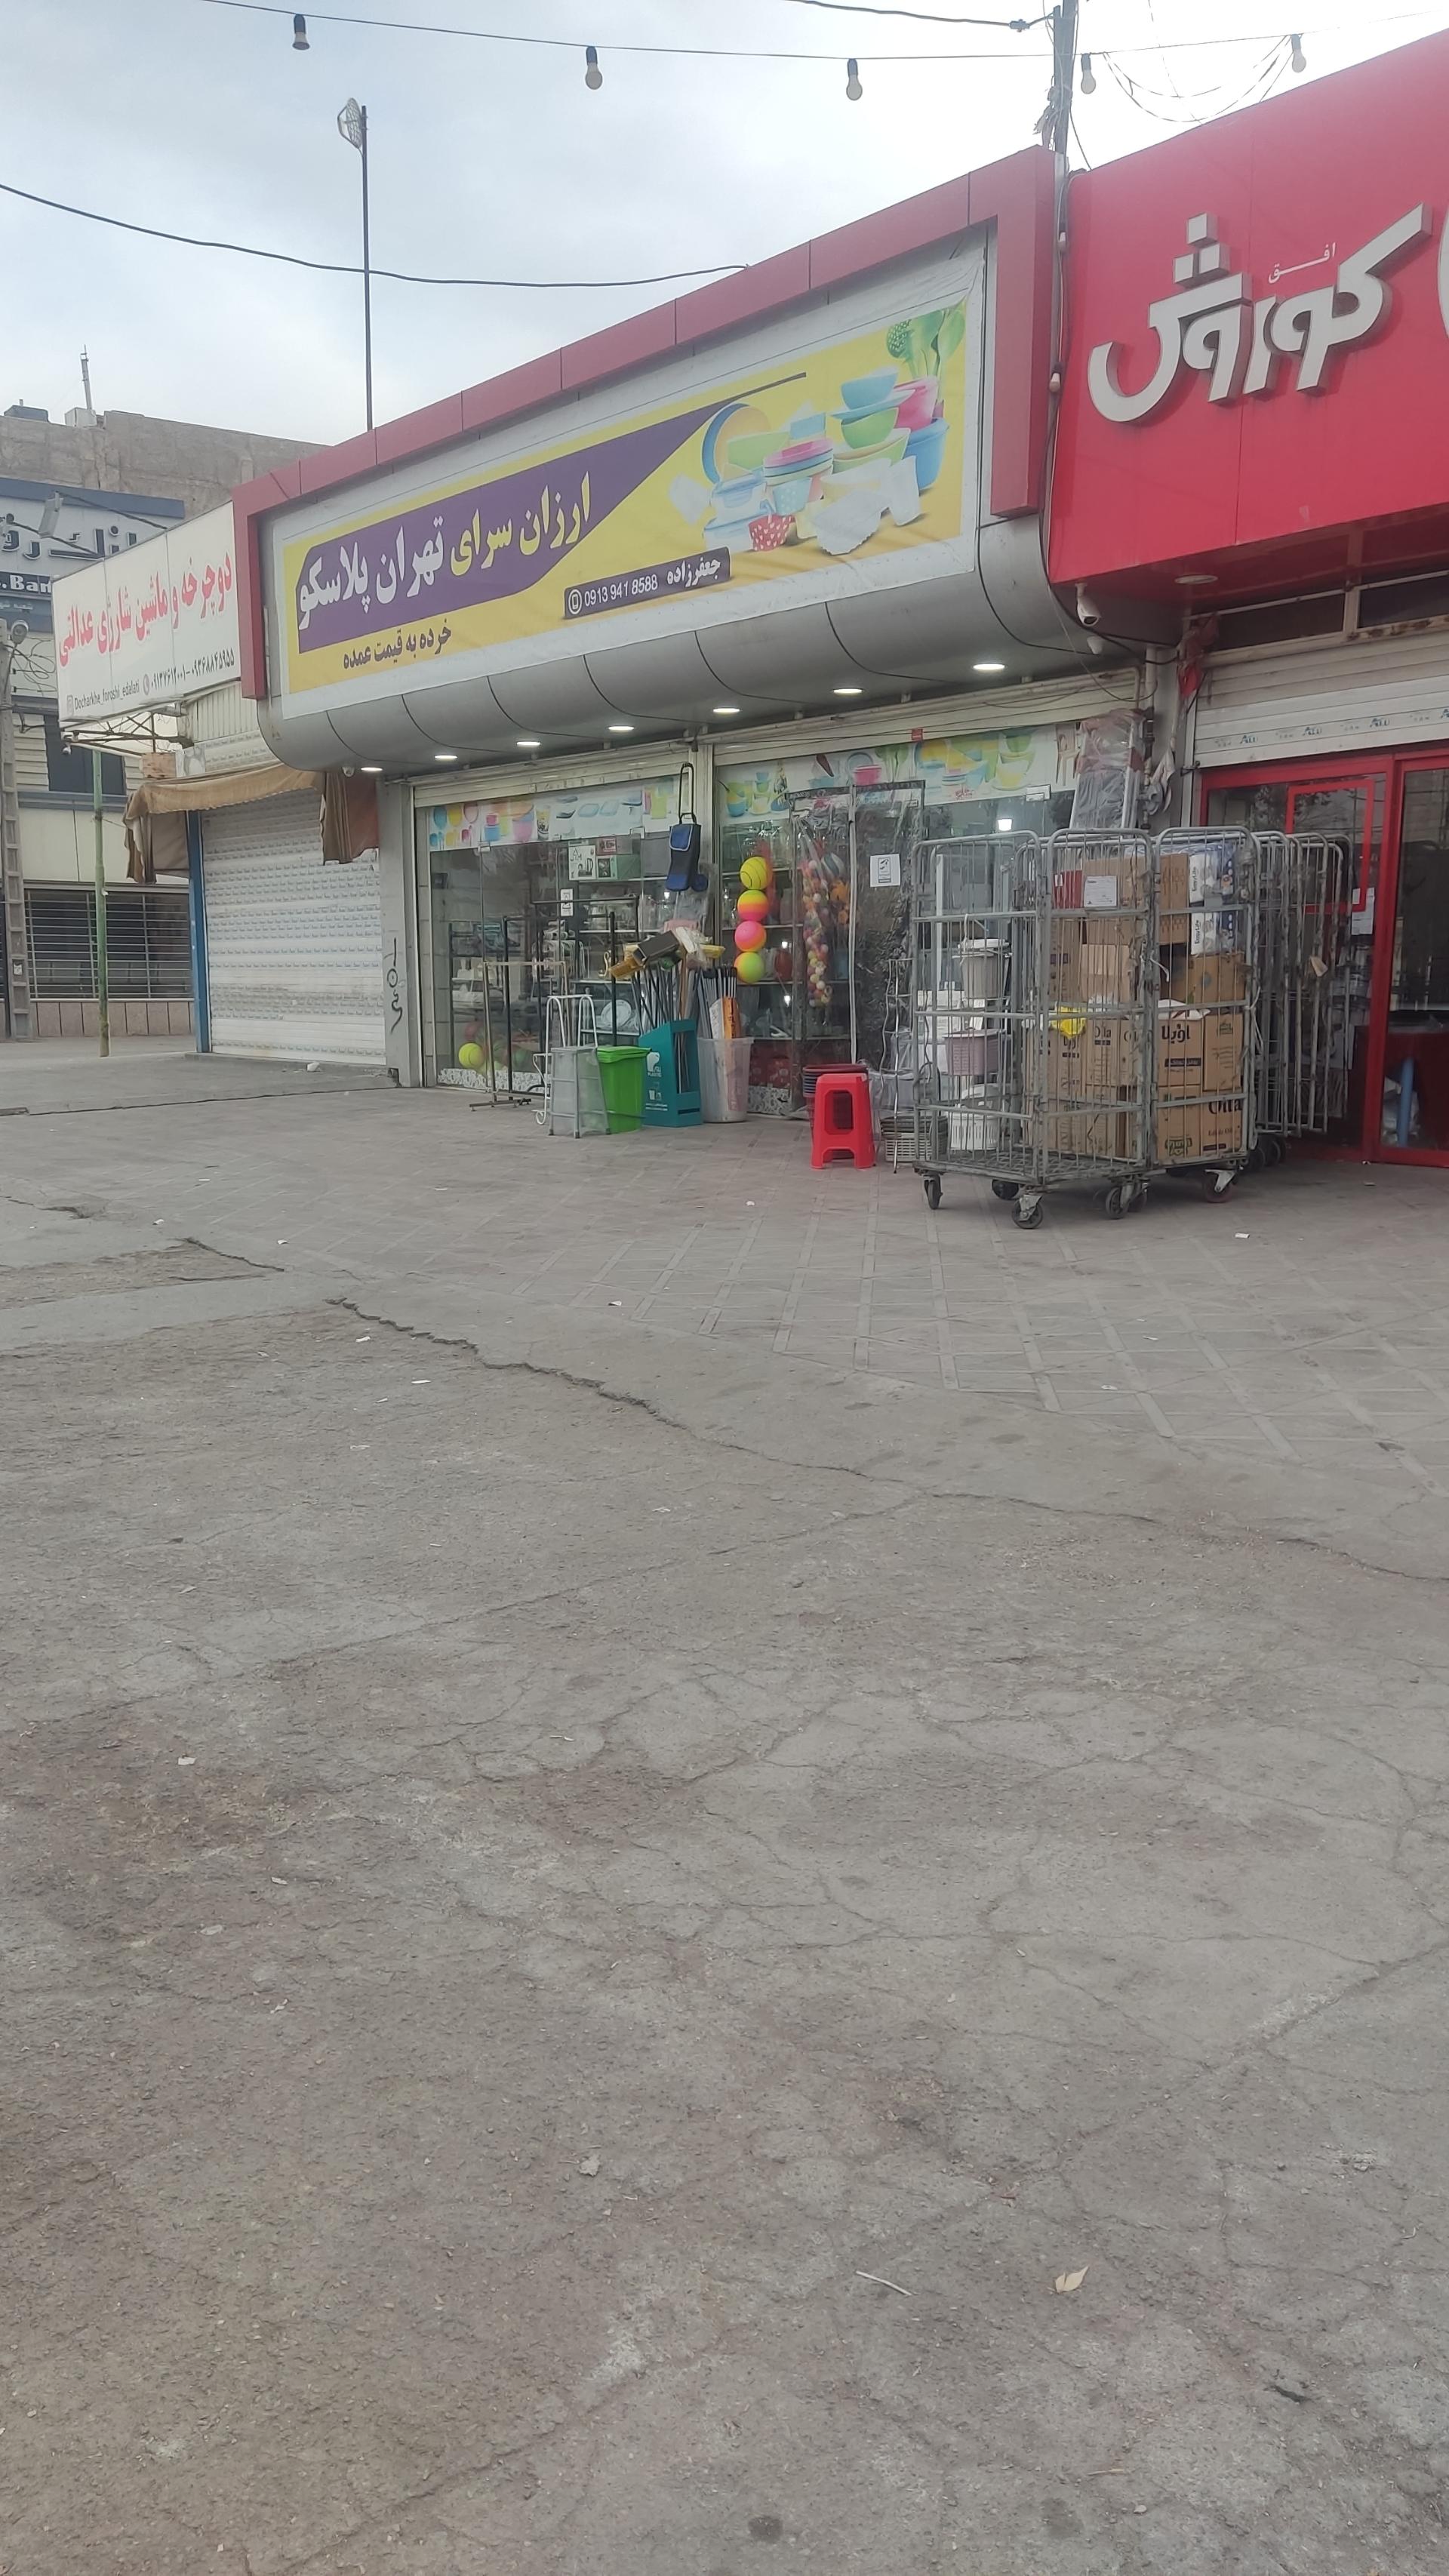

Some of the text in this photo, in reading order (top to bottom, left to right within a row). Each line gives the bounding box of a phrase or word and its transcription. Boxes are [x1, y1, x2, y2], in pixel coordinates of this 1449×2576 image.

[1269, 242, 1336, 284] افق
[1088, 202, 1432, 423] کوروش
[298, 470, 591, 630] ارزان سرای تهران پلاسکو
[584, 574, 658, 607] 0913 941 8588
[59, 552, 232, 667] دوچرخه و ماشین شارژی عدالتی
[343, 618, 452, 669] خرده به قیمت عمده
